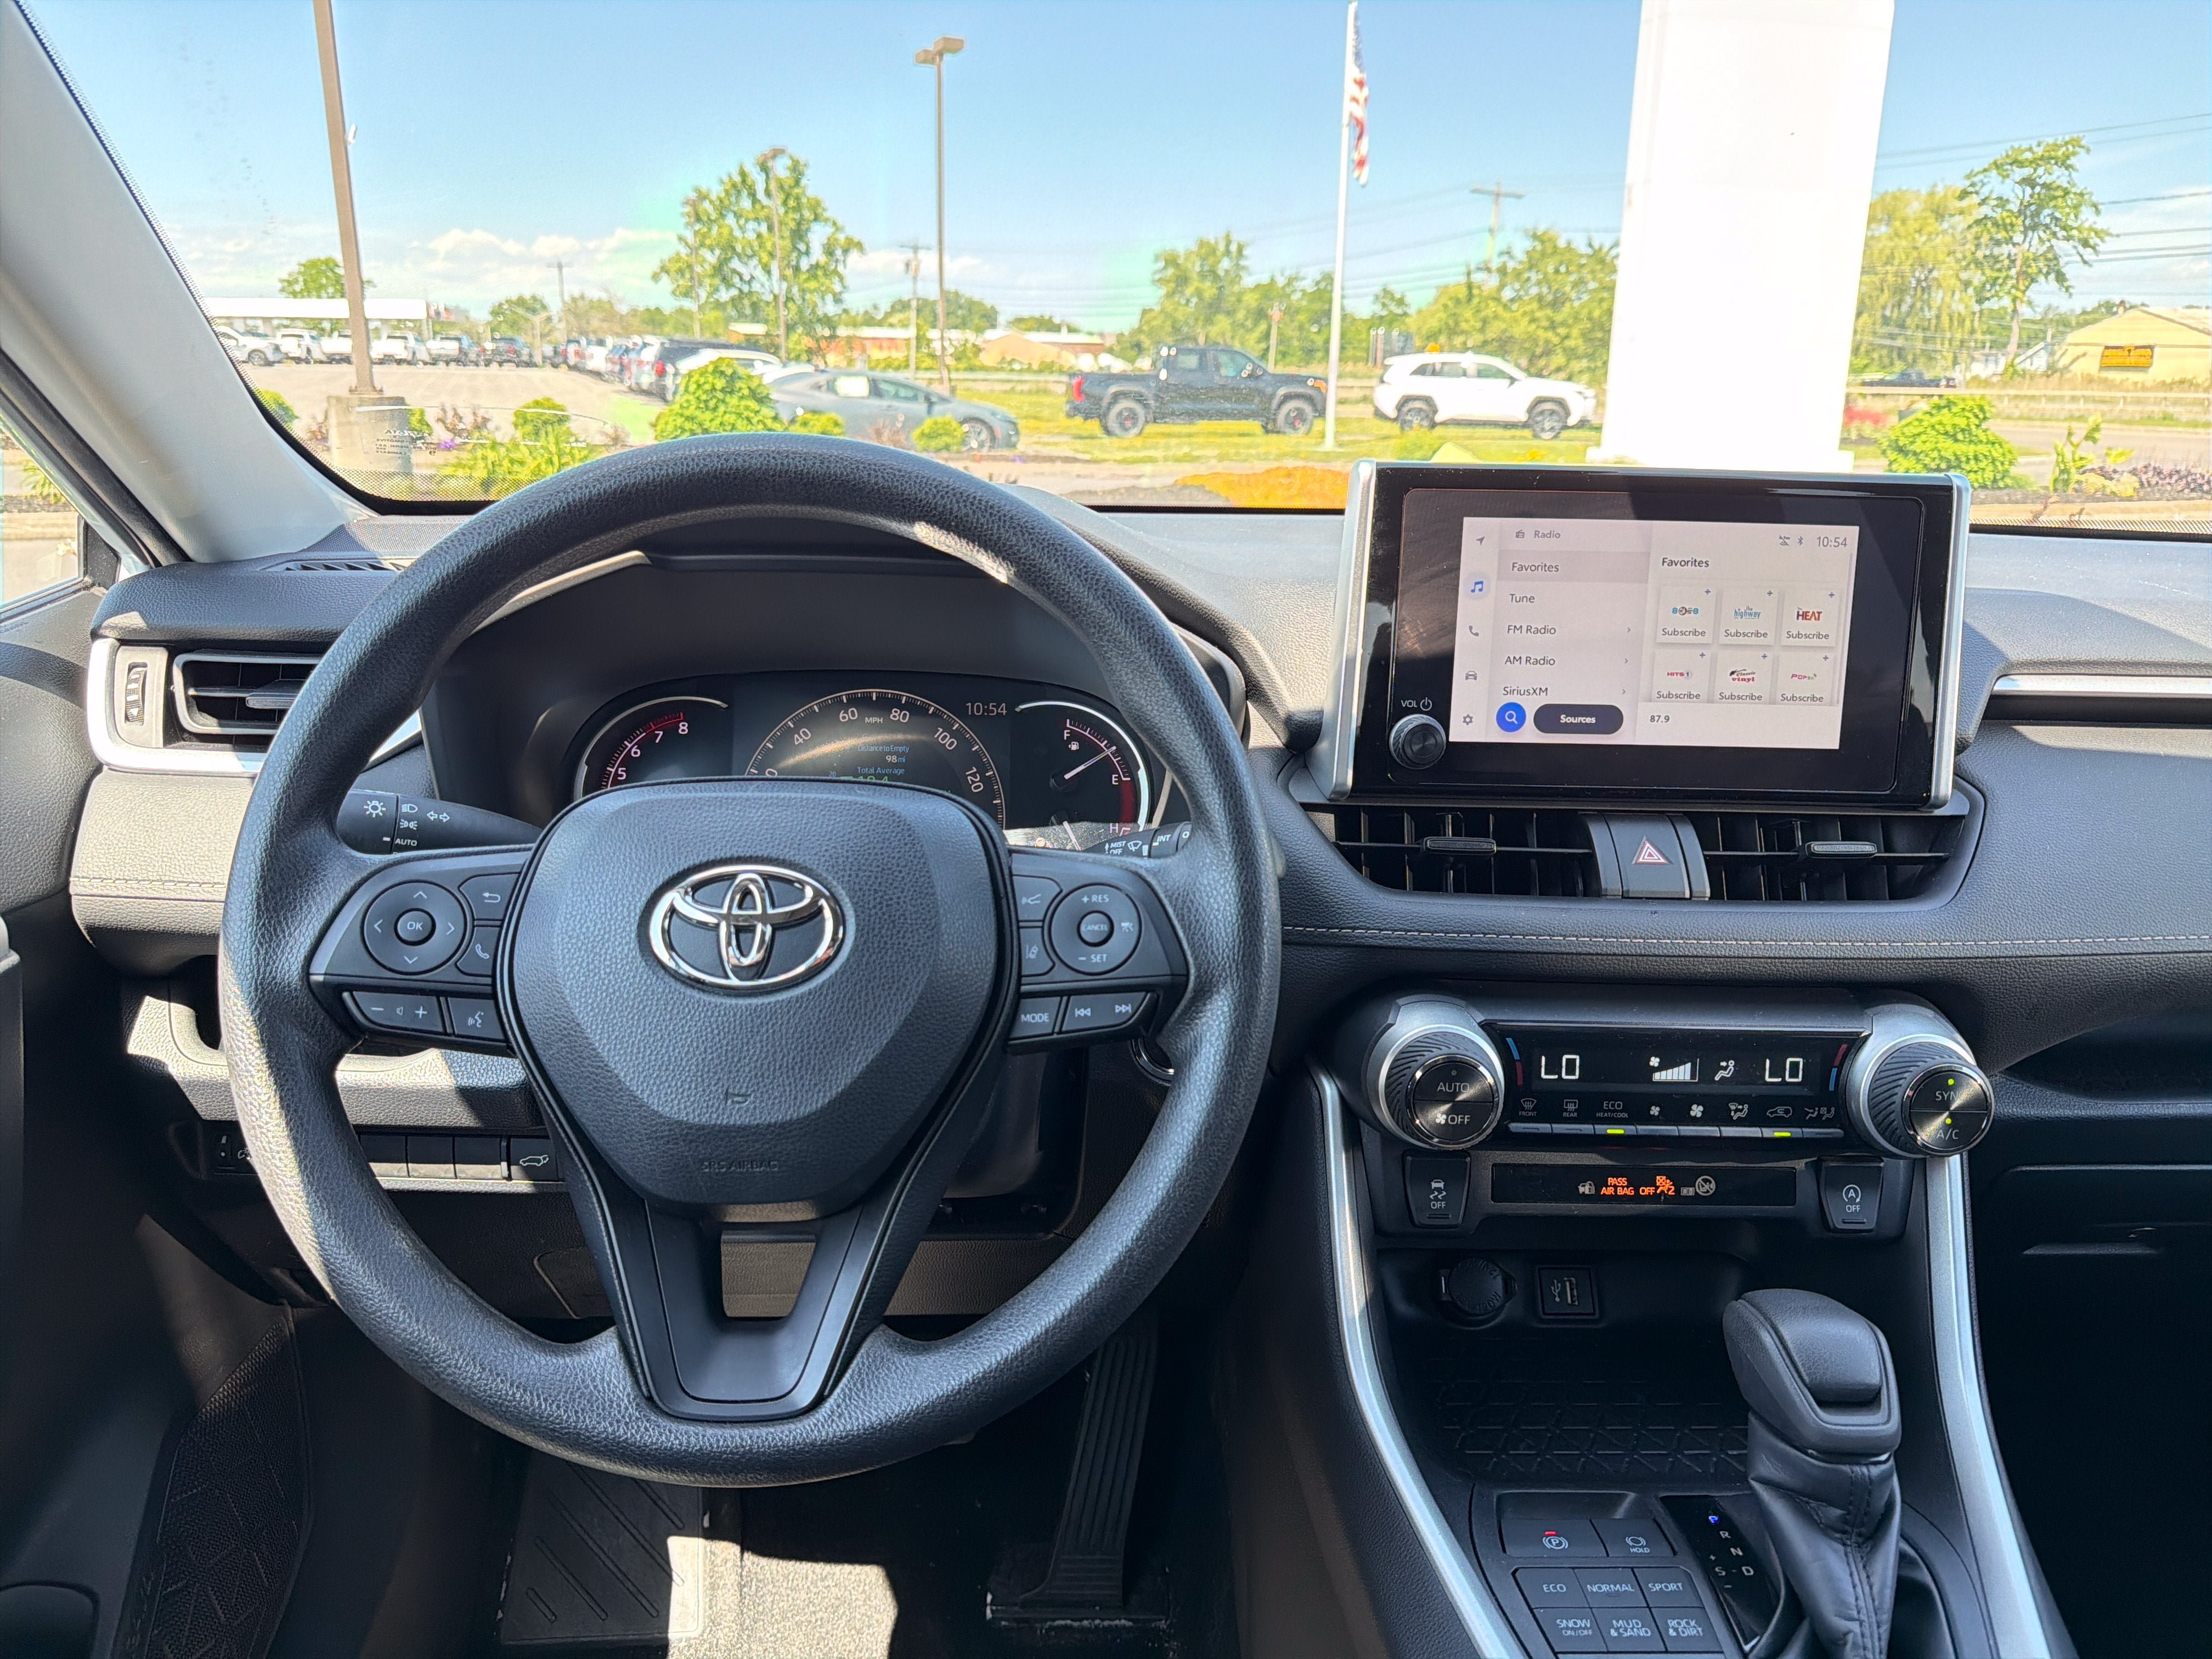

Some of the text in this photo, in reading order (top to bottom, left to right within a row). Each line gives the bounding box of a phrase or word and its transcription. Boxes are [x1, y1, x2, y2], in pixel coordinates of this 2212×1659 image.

[1534, 530, 1561, 539] Radio
[1816, 536, 1848, 548] 10:54
[1511, 562, 1560, 572] Favorites
[1662, 557, 1709, 568] Favorites
[1509, 594, 1535, 603] Tune
[1734, 608, 1760, 619] highway
[1796, 611, 1822, 621] HEAT
[1507, 624, 1556, 635] FM Radio
[1661, 628, 1706, 637] Subscribe
[1724, 629, 1768, 639] Subscribe
[1786, 631, 1830, 640] Subscribe
[1504, 656, 1555, 666] AM Radio
[1502, 686, 1548, 696] SiriusXM
[1656, 691, 1701, 700] Subscribe
[1719, 692, 1763, 701] Subscribe
[1781, 693, 1824, 703] Subscribe
[966, 702, 1007, 716] 10:54
[839, 708, 859, 722] 60
[890, 708, 910, 723] 80
[1560, 715, 1596, 724] Sources
[679, 722, 689, 734] 8
[654, 731, 663, 743] 7
[793, 728, 811, 746] 40
[933, 727, 957, 751] 100
[1064, 730, 1070, 740] F
[631, 745, 641, 757] 6
[617, 768, 627, 780] 5
[876, 768, 905, 776] Average
[965, 766, 984, 793] 120
[1112, 775, 1118, 785] E
[1110, 823, 1118, 833] H
[394, 838, 417, 847] AUTO
[1092, 894, 1109, 902] RES
[407, 921, 423, 930] OK
[1091, 954, 1107, 963] SET
[1021, 1012, 1049, 1022] MODE
[1541, 1054, 1580, 1079] LO
[1765, 1058, 1803, 1082] LO
[1437, 1082, 1470, 1092] AUTO
[1935, 1091, 1965, 1101] SYN
[1603, 1101, 1623, 1110] ECO
[1448, 1115, 1471, 1125] OFF
[1936, 1128, 1959, 1140] A/C
[1608, 1178, 1627, 1186] PASS
[1600, 1187, 1615, 1195] AIR
[1617, 1187, 1634, 1195] BAG
[1639, 1187, 1655, 1195] OFF
[1730, 1547, 1743, 1556] N
[1715, 1567, 1726, 1576] S
[1742, 1566, 1754, 1576] D
[1543, 1584, 1566, 1592] ECO
[1587, 1584, 1634, 1592] NORMAL
[1649, 1583, 1683, 1592] SPORT
[1556, 1619, 1591, 1628] SNOW
[1612, 1620, 1641, 1628] MUD
[1667, 1619, 1697, 1628] ROCK
[1620, 1628, 1651, 1637] SAND
[1679, 1628, 1702, 1637] DIRT
